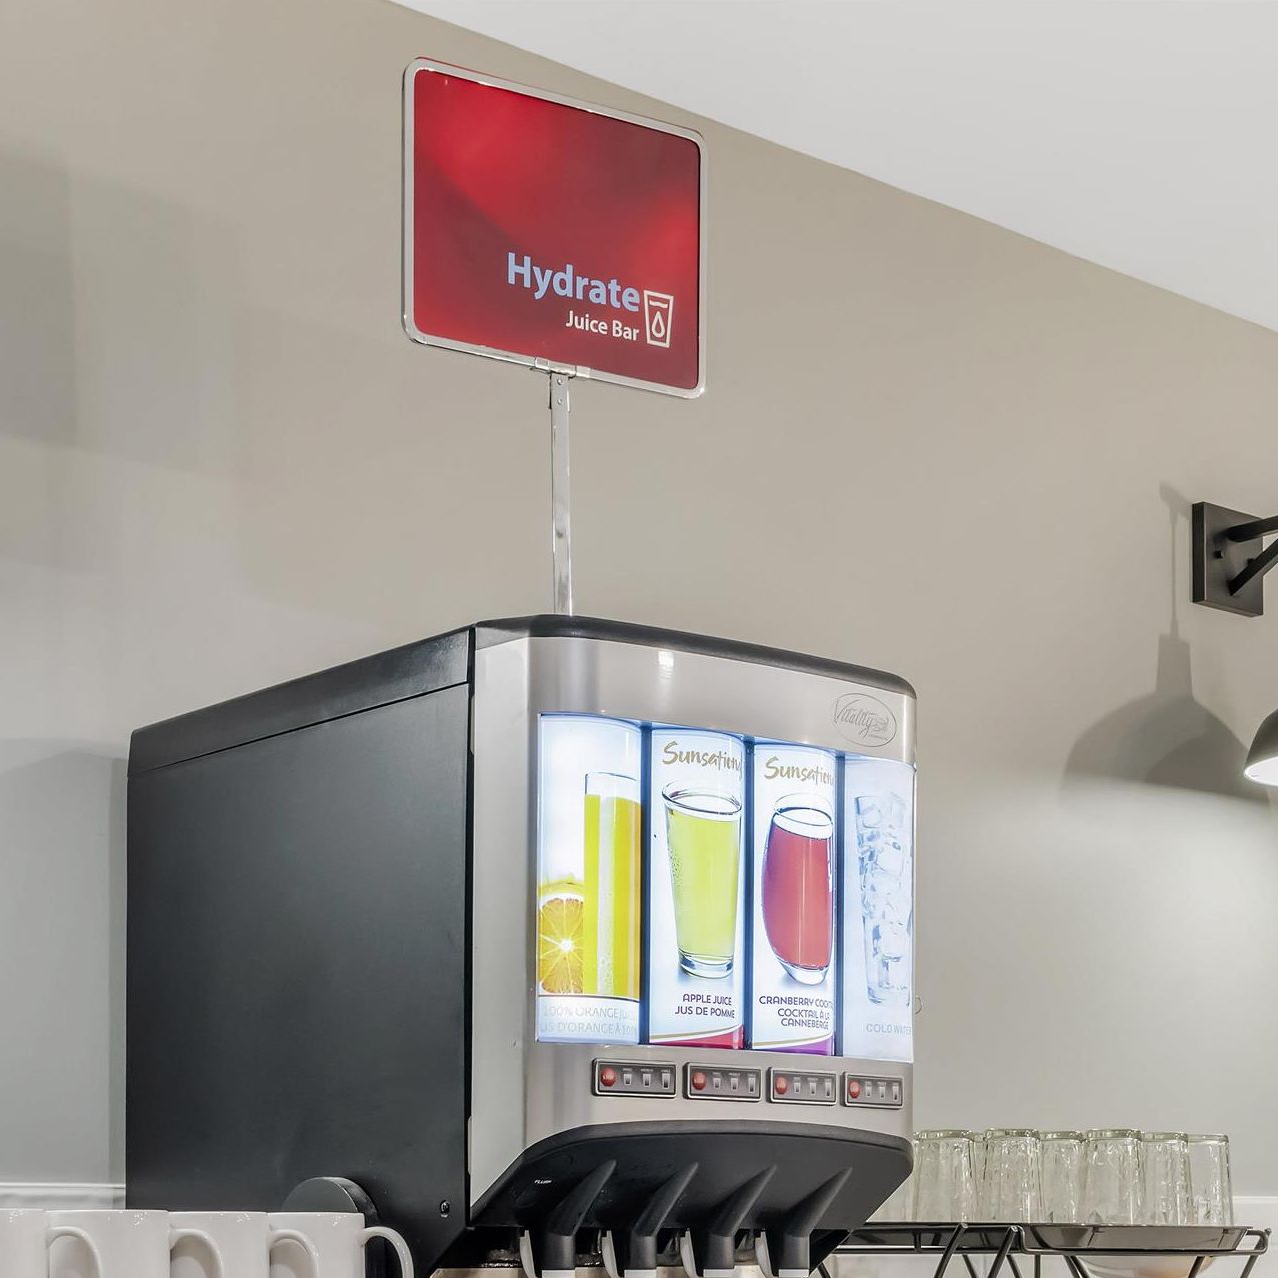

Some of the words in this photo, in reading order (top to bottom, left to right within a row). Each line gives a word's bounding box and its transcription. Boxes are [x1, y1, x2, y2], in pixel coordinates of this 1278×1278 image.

[507, 251, 640, 312] Hydrate
[565, 310, 608, 335] Juice
[612, 319, 640, 341] Bar
[682, 993, 712, 1004] APPLE
[712, 995, 732, 1006] JUICE
[758, 995, 814, 1007] CRANBERRY
[674, 1006, 693, 1015] JUS
[695, 1006, 709, 1016] DE
[710, 1007, 735, 1019] POMME
[777, 1008, 819, 1019] COCKTAIL
[780, 1018, 830, 1031] CANNEBERGE
